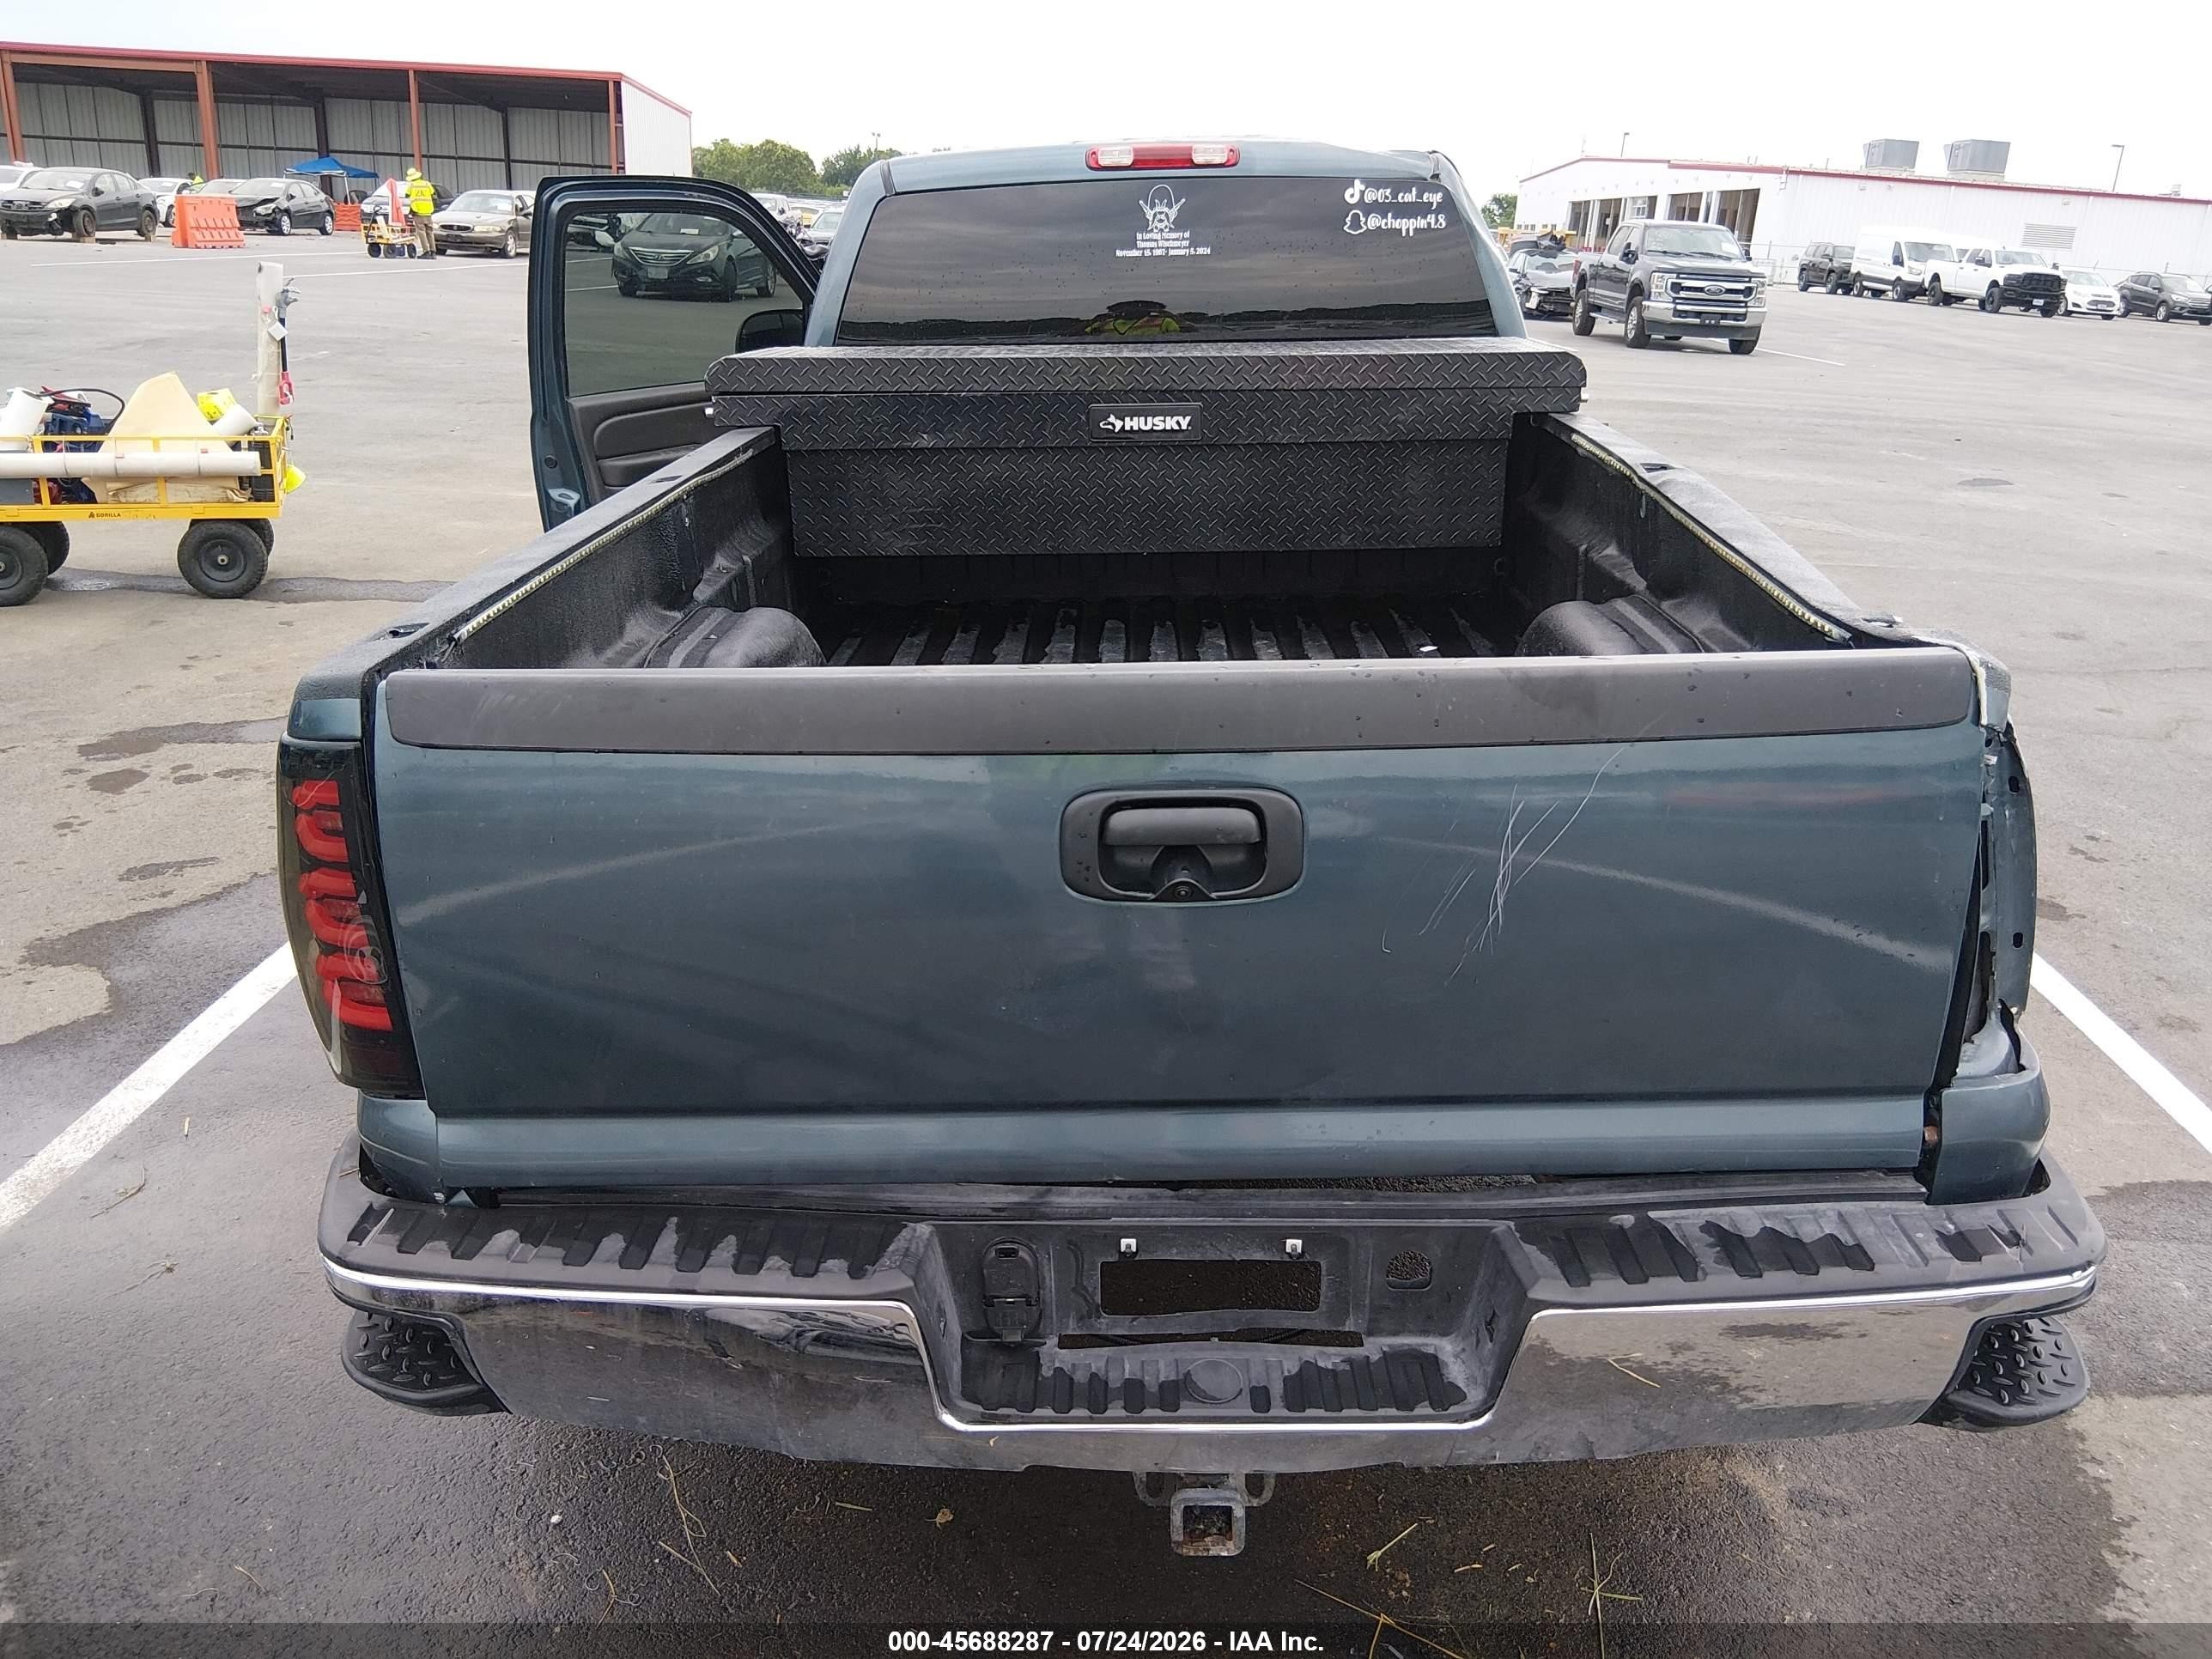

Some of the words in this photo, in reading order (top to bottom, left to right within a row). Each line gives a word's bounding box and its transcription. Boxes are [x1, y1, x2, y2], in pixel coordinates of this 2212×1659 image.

[1364, 186, 1443, 210] @03_cat_eye
[1366, 212, 1446, 236] @choppin4.8
[1143, 232, 1161, 240] Loving
[1124, 416, 1192, 431] HUSKY
